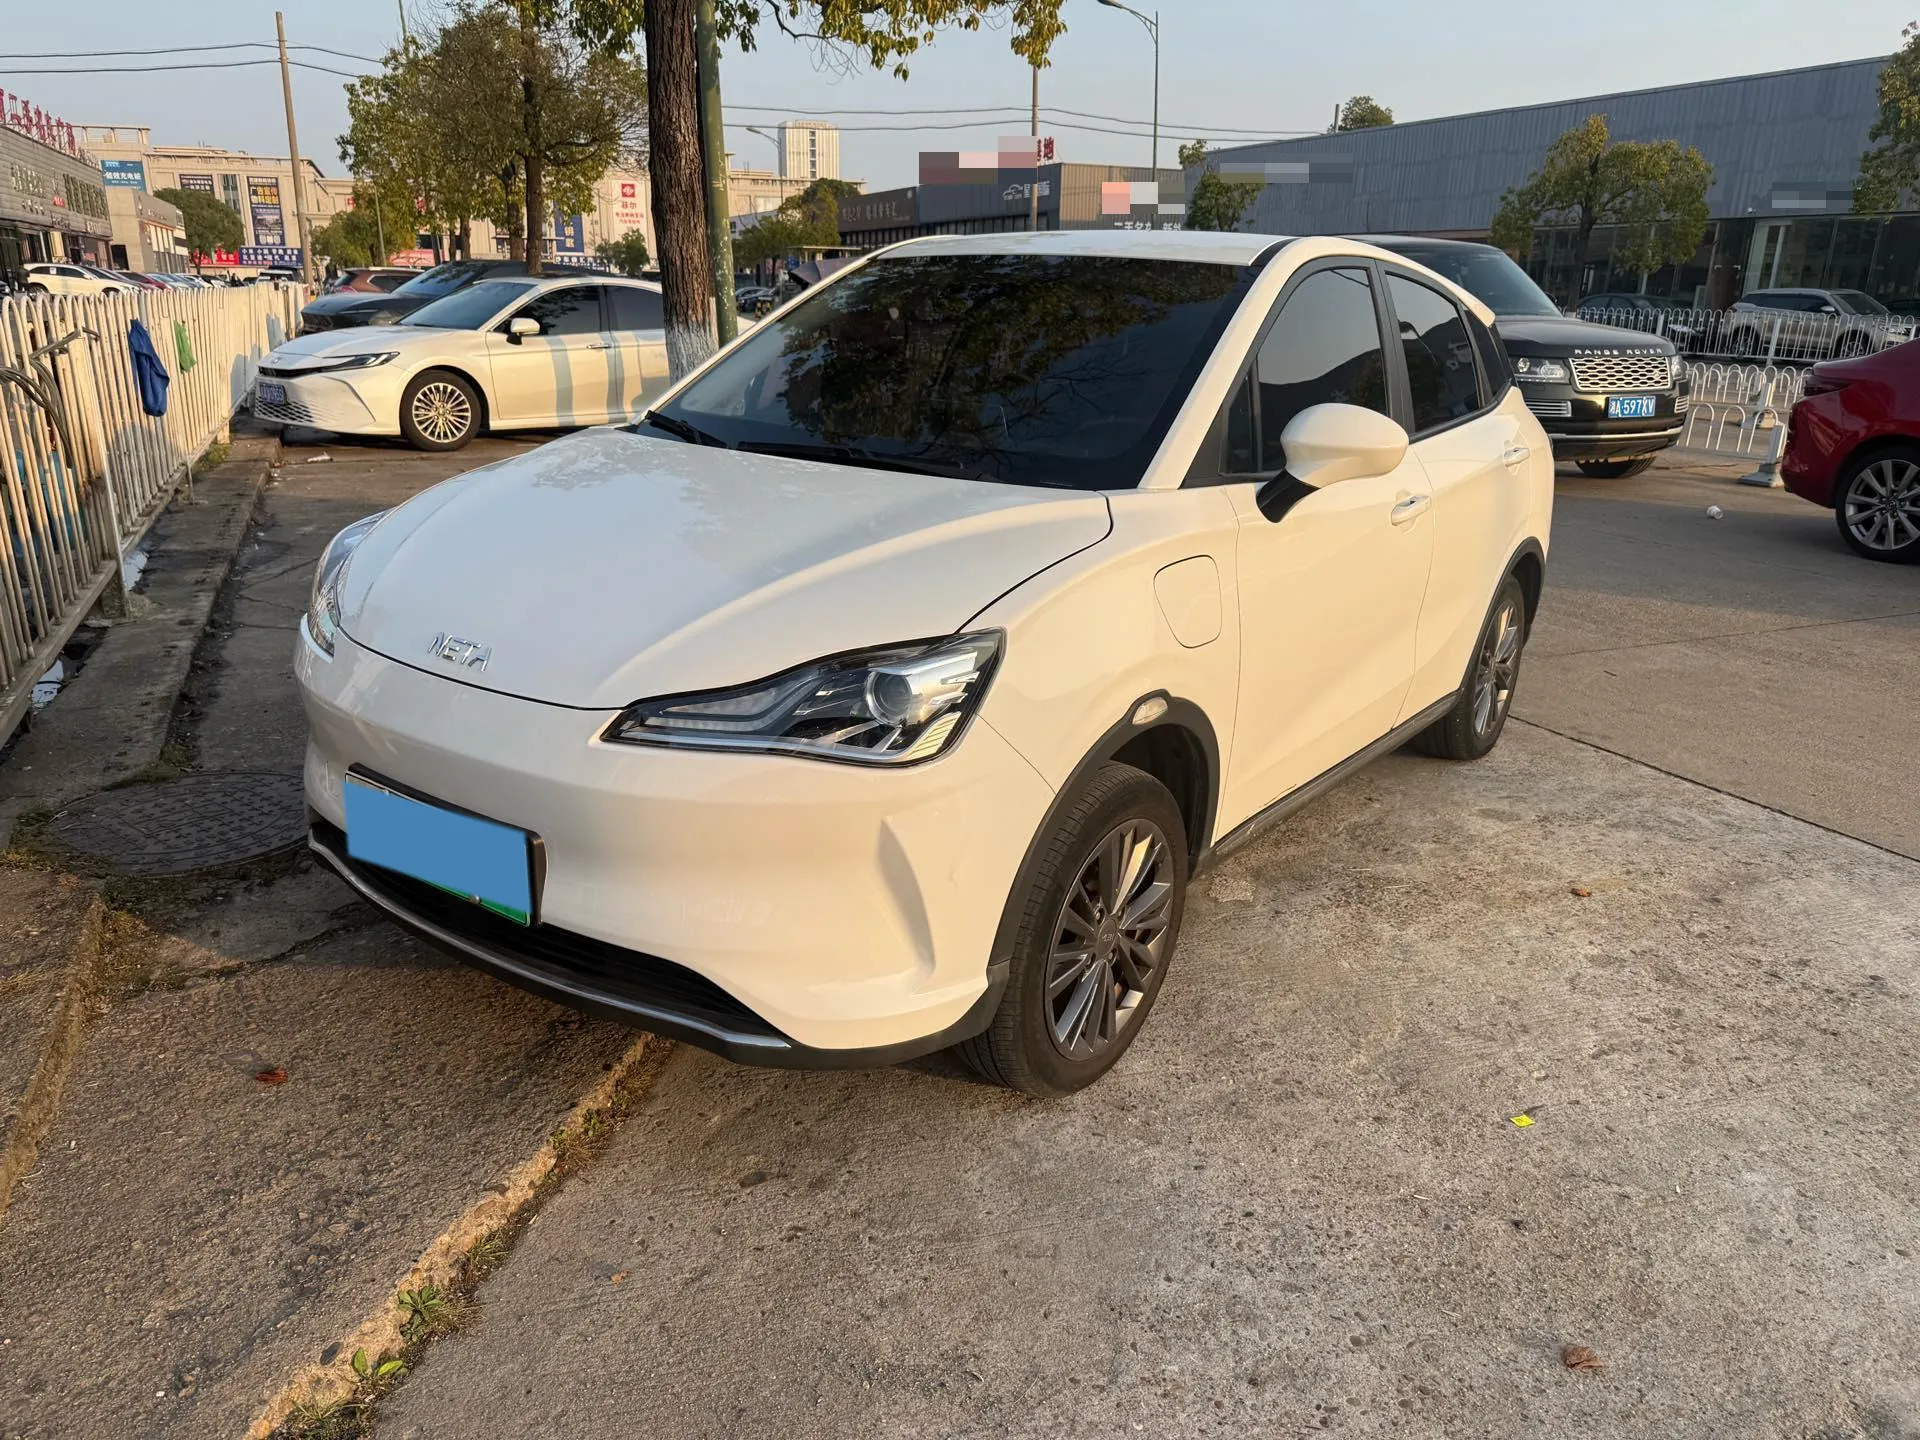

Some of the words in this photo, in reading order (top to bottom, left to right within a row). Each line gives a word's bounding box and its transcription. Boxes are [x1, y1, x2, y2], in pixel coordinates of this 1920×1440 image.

[1575, 348, 1619, 356] RANGE
[1626, 347, 1663, 355] ROVER
[428, 632, 492, 672] NETA
